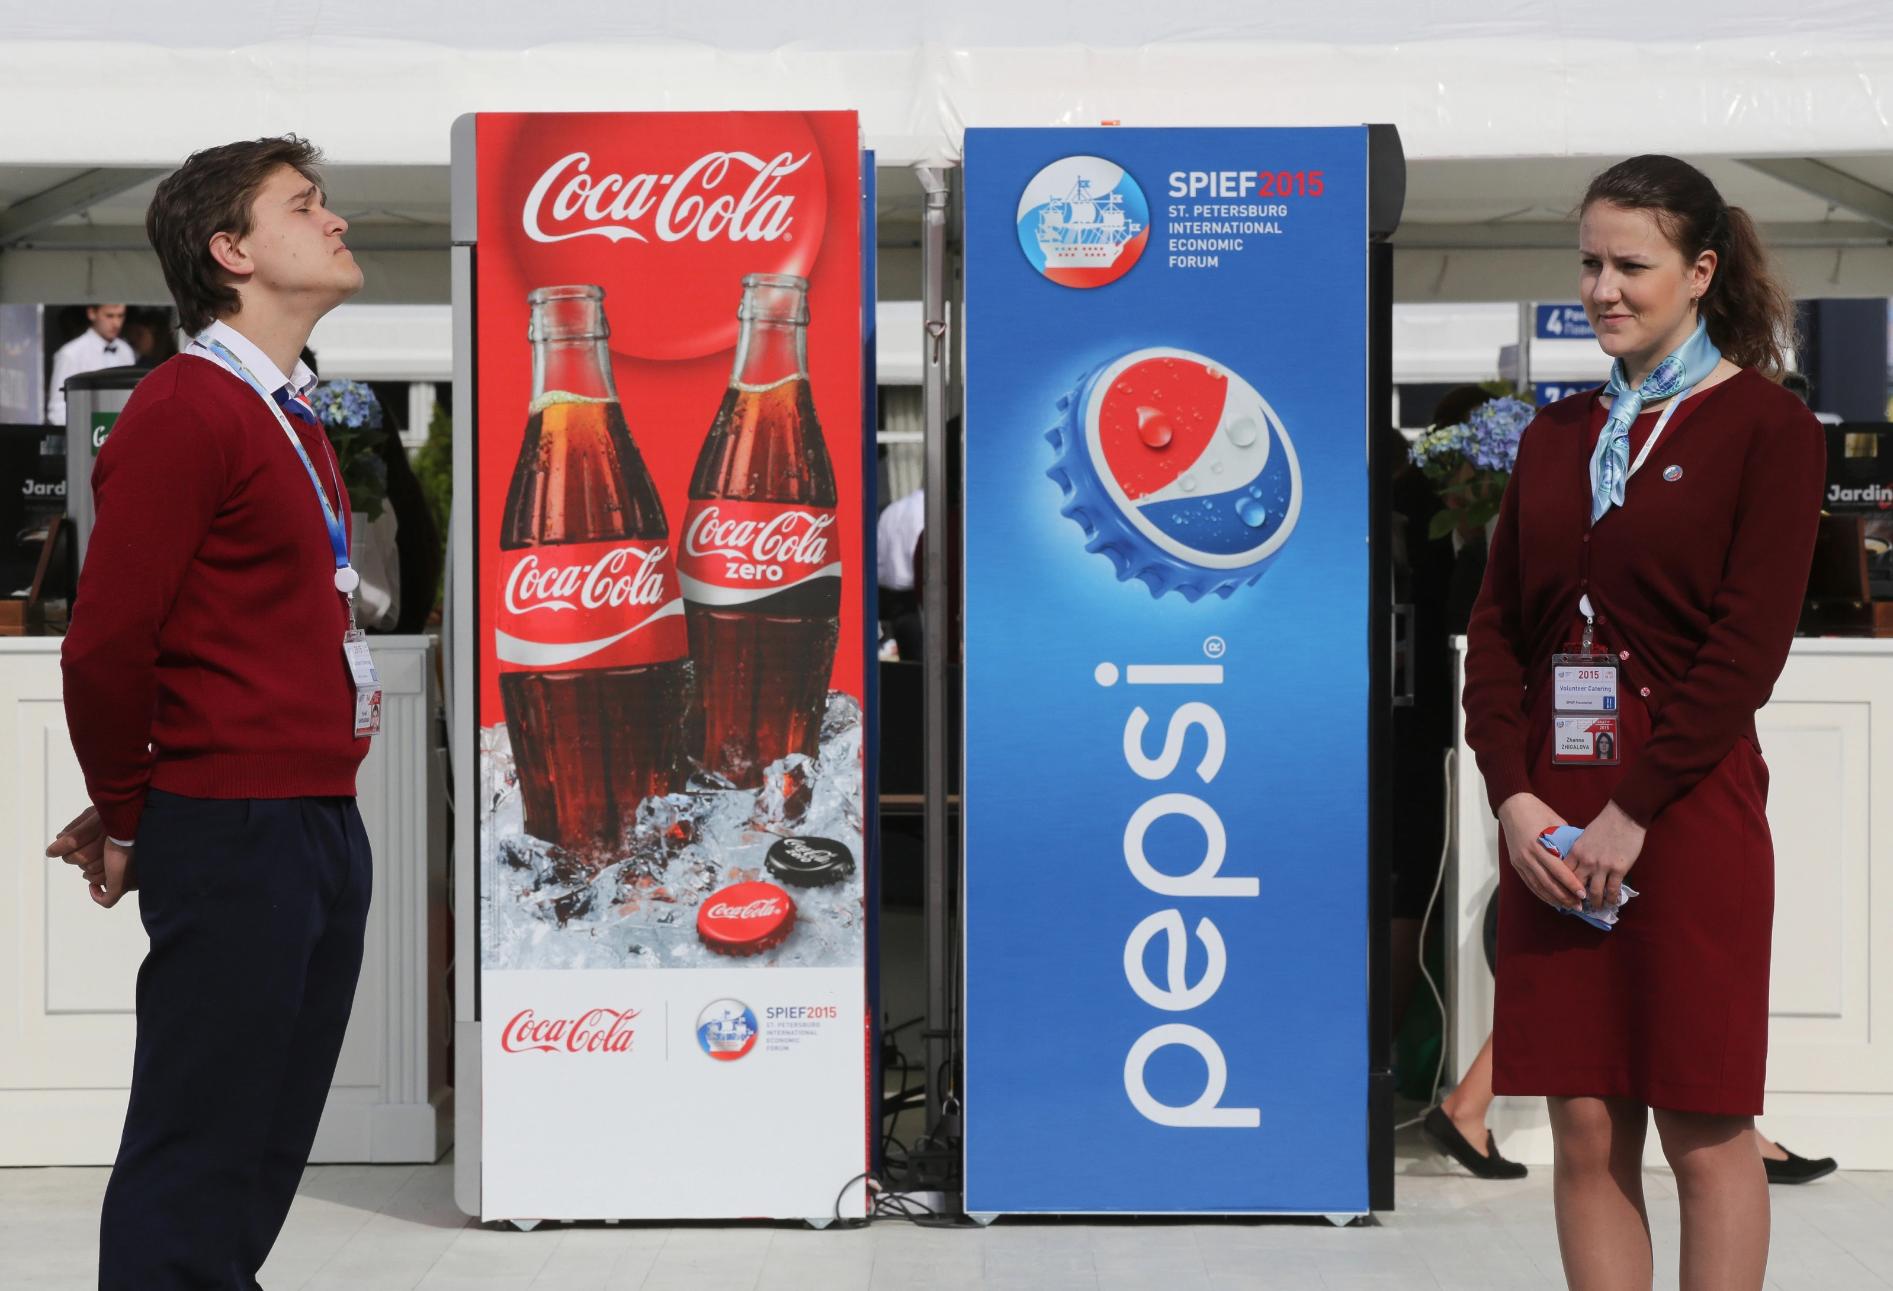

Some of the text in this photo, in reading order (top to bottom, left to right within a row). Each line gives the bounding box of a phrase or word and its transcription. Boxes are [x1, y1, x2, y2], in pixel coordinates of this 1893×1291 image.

[522, 151, 811, 243] Coca-Cola
[1168, 205, 1288, 217] ST. PETERSBURG
[1168, 222, 1283, 234] INTERNATIONAL
[1168, 239, 1244, 251] ECONOMIC
[1168, 256, 1219, 268] FORUM
[1827, 484, 1893, 501] Jardin
[686, 505, 836, 565] Coca-Cola
[505, 546, 670, 615] Coca-Cola
[725, 562, 783, 581] zero
[1578, 670, 1599, 679] 2015
[1094, 662, 1260, 1127] pepsi
[707, 897, 781, 919] Coca-Cola
[501, 1008, 643, 1054] Coca-Cola
